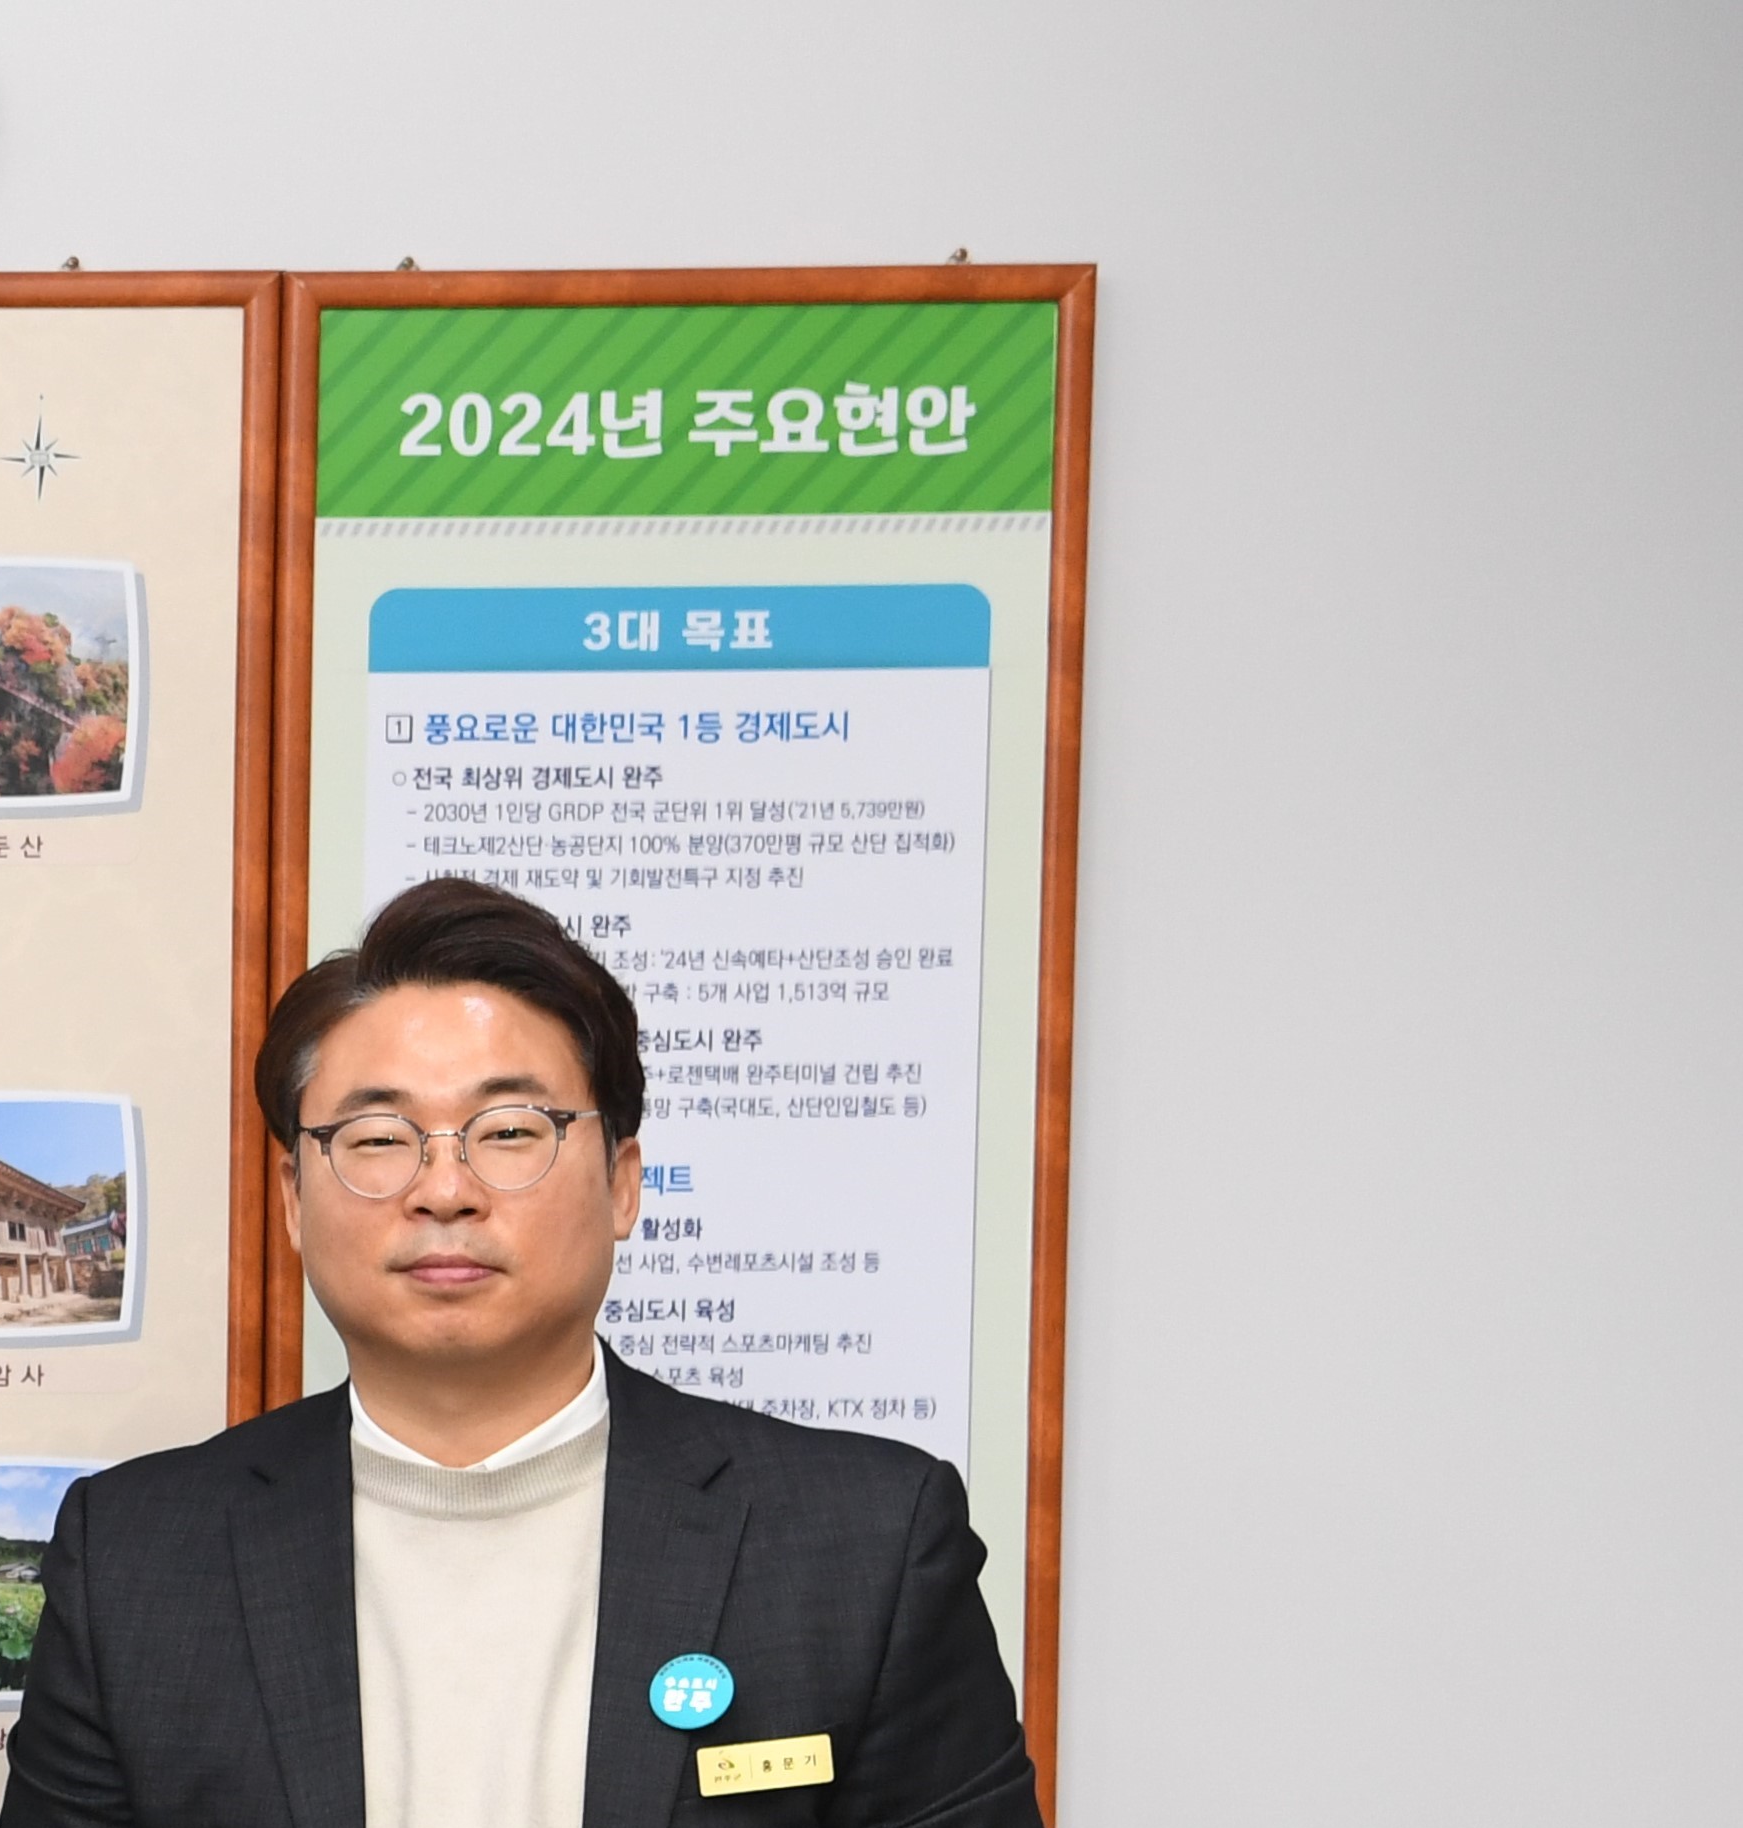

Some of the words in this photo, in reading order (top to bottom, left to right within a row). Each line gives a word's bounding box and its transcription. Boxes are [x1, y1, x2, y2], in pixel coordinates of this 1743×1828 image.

[400, 389, 662, 458] 2024년
[689, 382, 976, 457] 주요현안
[583, 610, 659, 651] 3대
[682, 610, 772, 651] 목표
[425, 713, 538, 745] 풍요로운
[552, 713, 665, 744] 대한민국
[679, 712, 722, 744] 1등
[736, 711, 848, 743] 경제도시
[413, 767, 452, 790] 전국
[462, 766, 522, 790] 최상위
[532, 766, 613, 790] 경제도시
[623, 766, 663, 789] 완주
[424, 802, 487, 823] 2030년
[548, 803, 604, 822] GRDP
[631, 835, 680, 854] 100%
[779, 982, 846, 1003] 1,513억
[642, 1218, 702, 1241] 활성화
[695, 1299, 734, 1322] 육성
